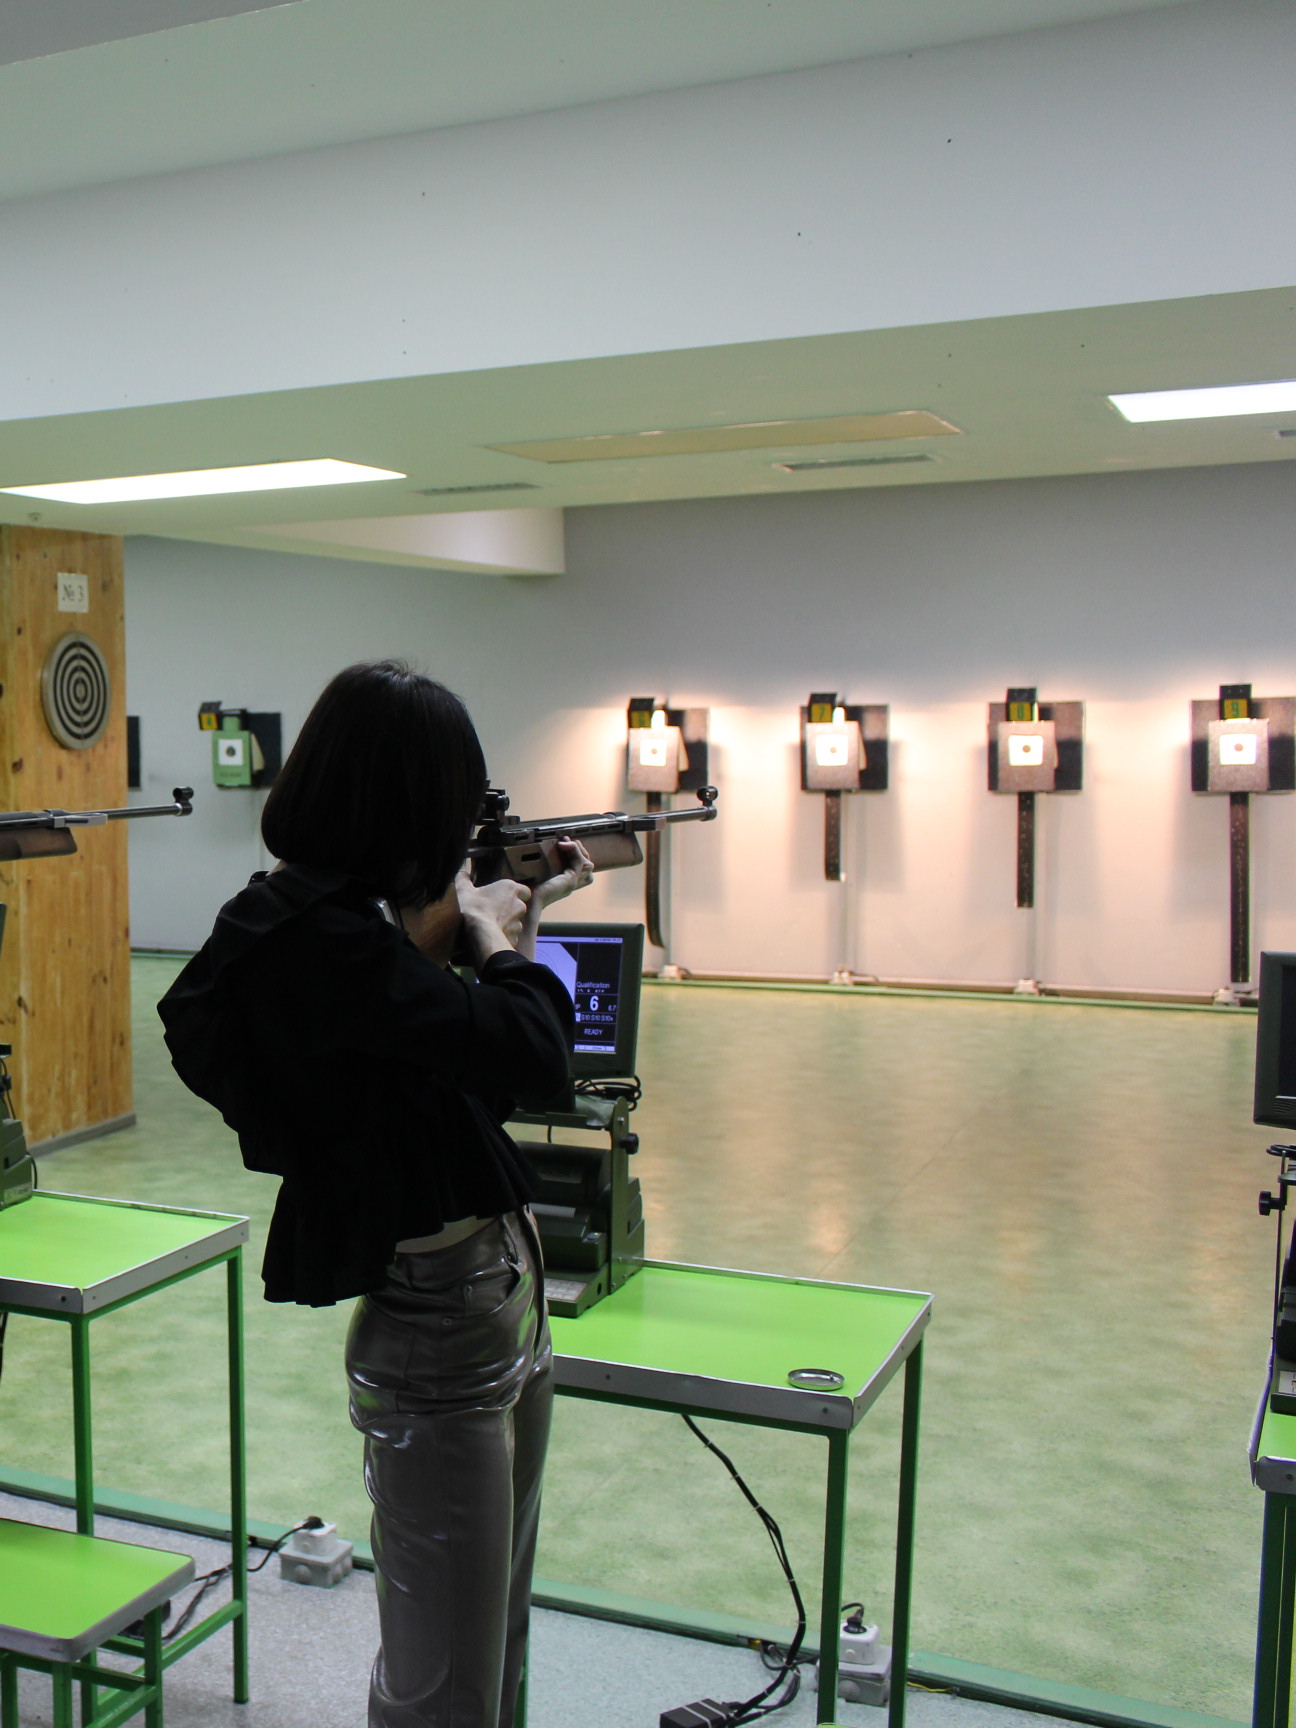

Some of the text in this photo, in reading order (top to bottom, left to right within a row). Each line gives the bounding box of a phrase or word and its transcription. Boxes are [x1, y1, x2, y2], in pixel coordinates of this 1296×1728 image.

[576, 981, 610, 989] Qualification
[589, 995, 599, 1011] 6
[584, 1028, 603, 1036] READY
